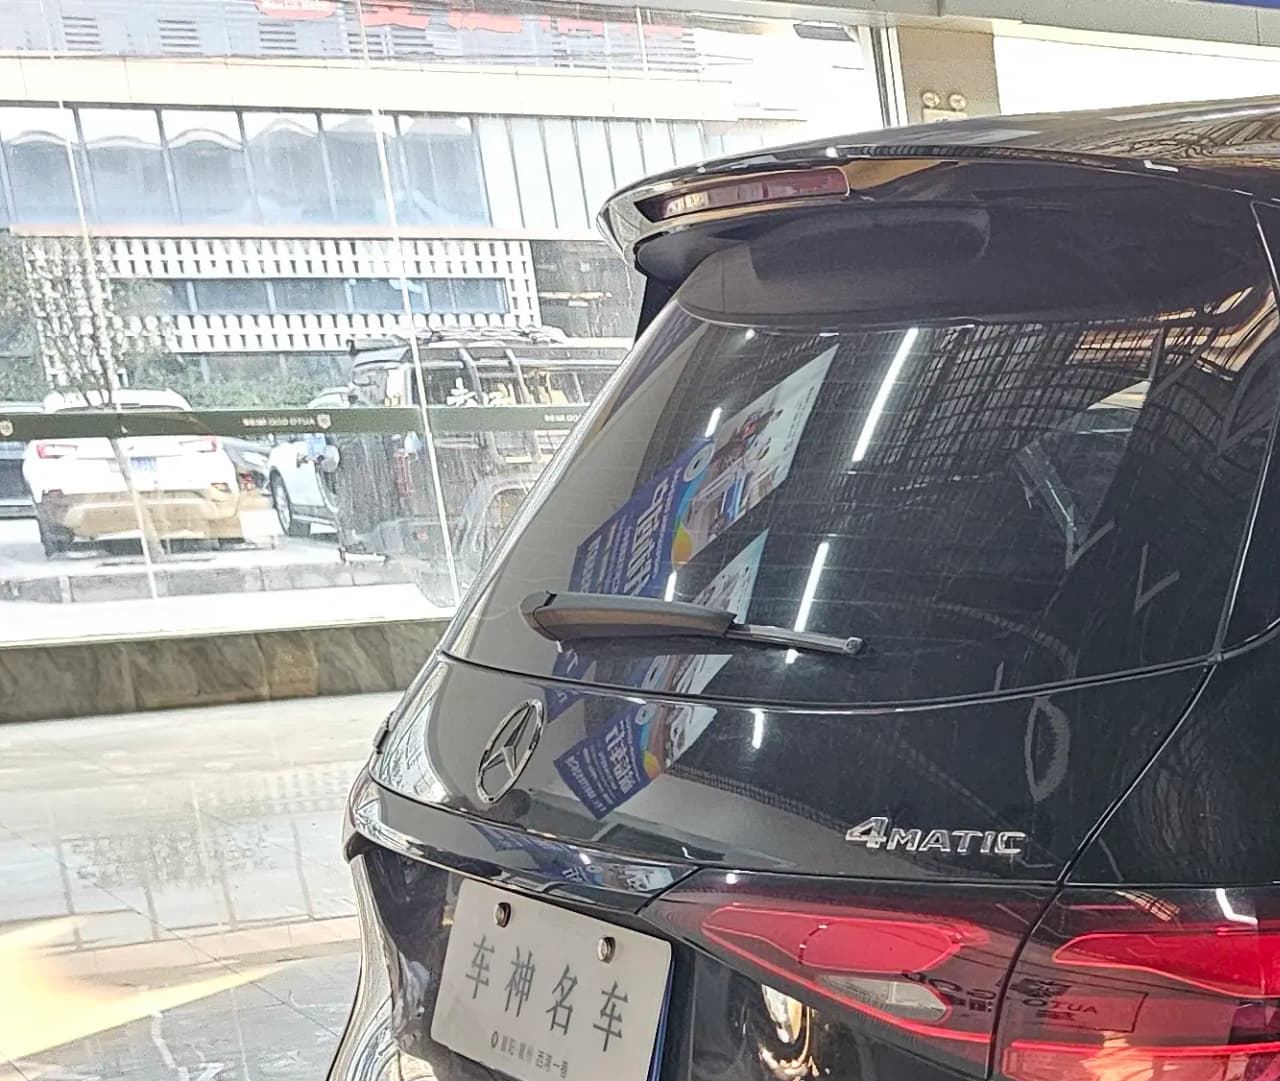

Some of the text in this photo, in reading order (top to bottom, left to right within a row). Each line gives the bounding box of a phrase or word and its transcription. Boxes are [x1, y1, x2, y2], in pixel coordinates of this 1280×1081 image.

[846, 817, 1026, 854] 4MATIC
[464, 934, 630, 1052] 车神名车
